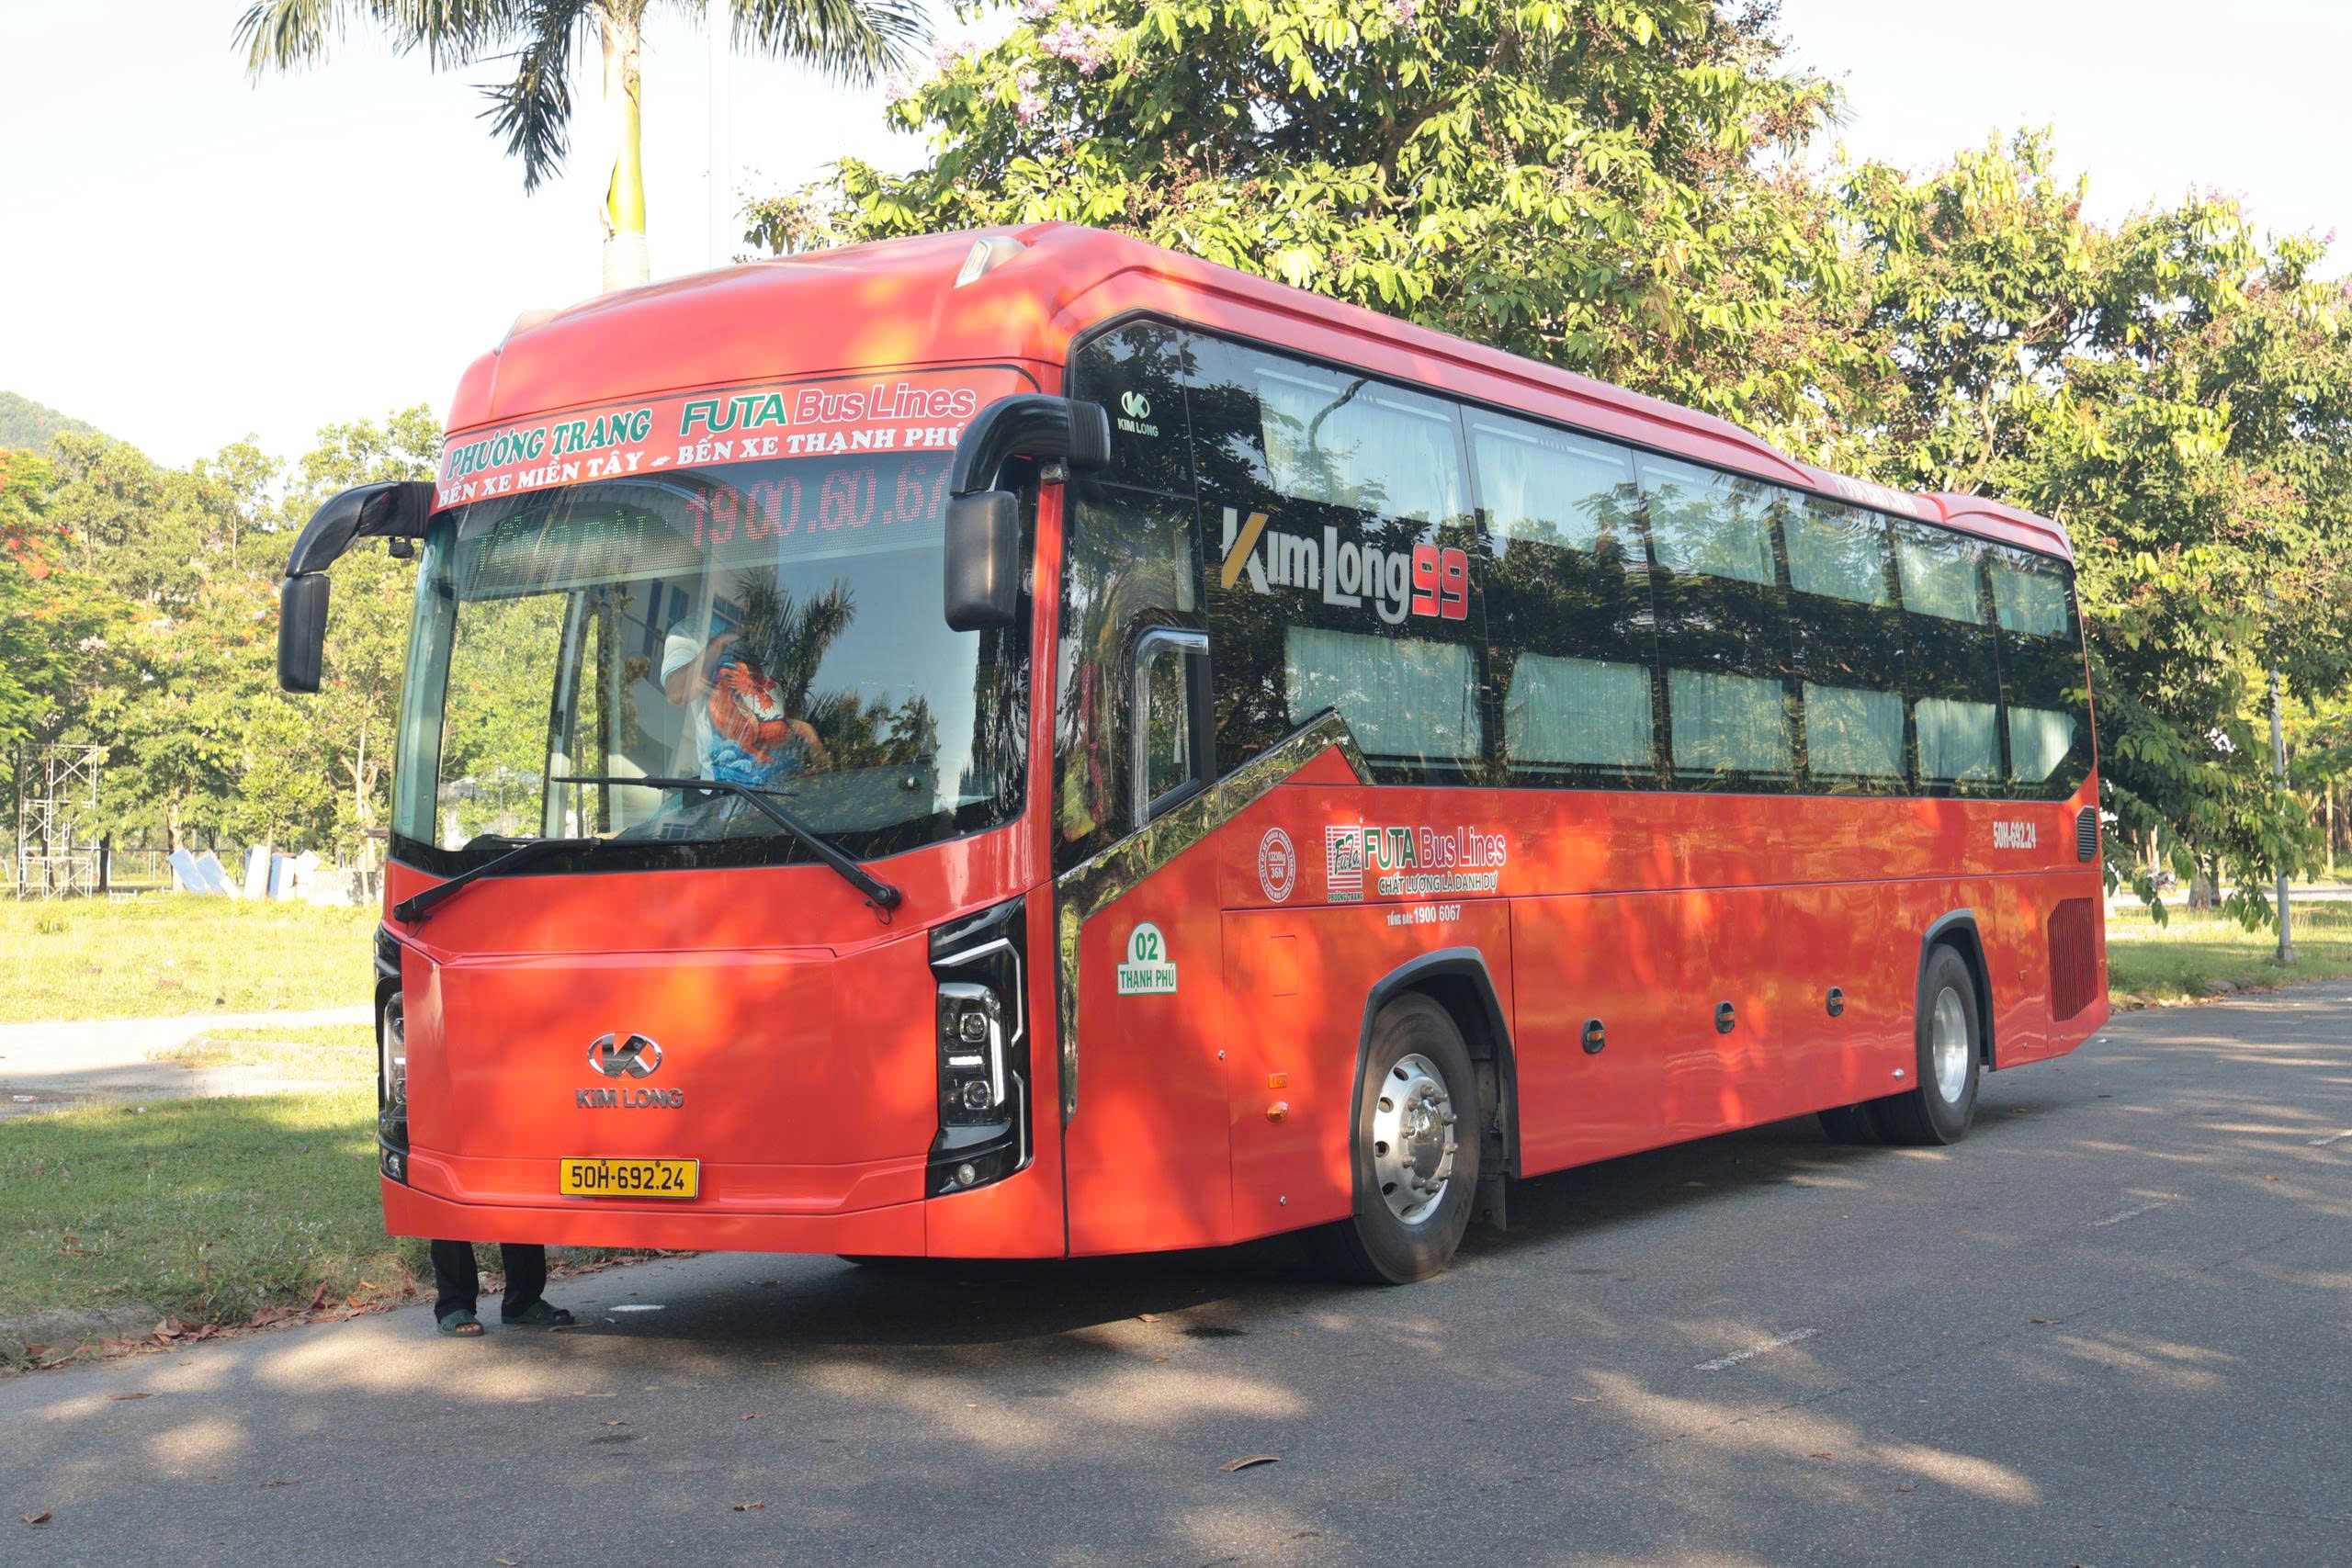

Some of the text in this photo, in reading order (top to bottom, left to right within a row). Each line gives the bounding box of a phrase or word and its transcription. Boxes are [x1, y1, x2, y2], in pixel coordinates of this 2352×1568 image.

[679, 382, 977, 436] FUTA Bus Lines
[1117, 418, 1159, 437] KIM LONG
[446, 408, 652, 482] PHƯƠNG TRANG
[438, 477, 478, 508] BẾN
[481, 475, 512, 496] XE
[516, 455, 581, 490] MIỀN
[586, 450, 645, 478] TÂY
[676, 434, 733, 465] BẾN
[739, 436, 779, 457] XE
[786, 426, 897, 454] THẠNH
[1362, 827, 1507, 870] FUTA Bus Lines
[1272, 867, 1284, 878] 36N
[1406, 873, 1441, 897] LƯỢNG
[1441, 871, 1454, 891] LÀ
[1455, 873, 1483, 891] DANH
[1483, 870, 1498, 894] DỰ
[1414, 906, 1436, 924] 1900
[1439, 904, 1461, 922] 6067
[1136, 932, 1158, 961] 02
[1120, 964, 1174, 992] THẠNH PHÚ
[576, 1088, 684, 1109] KIM LONG
